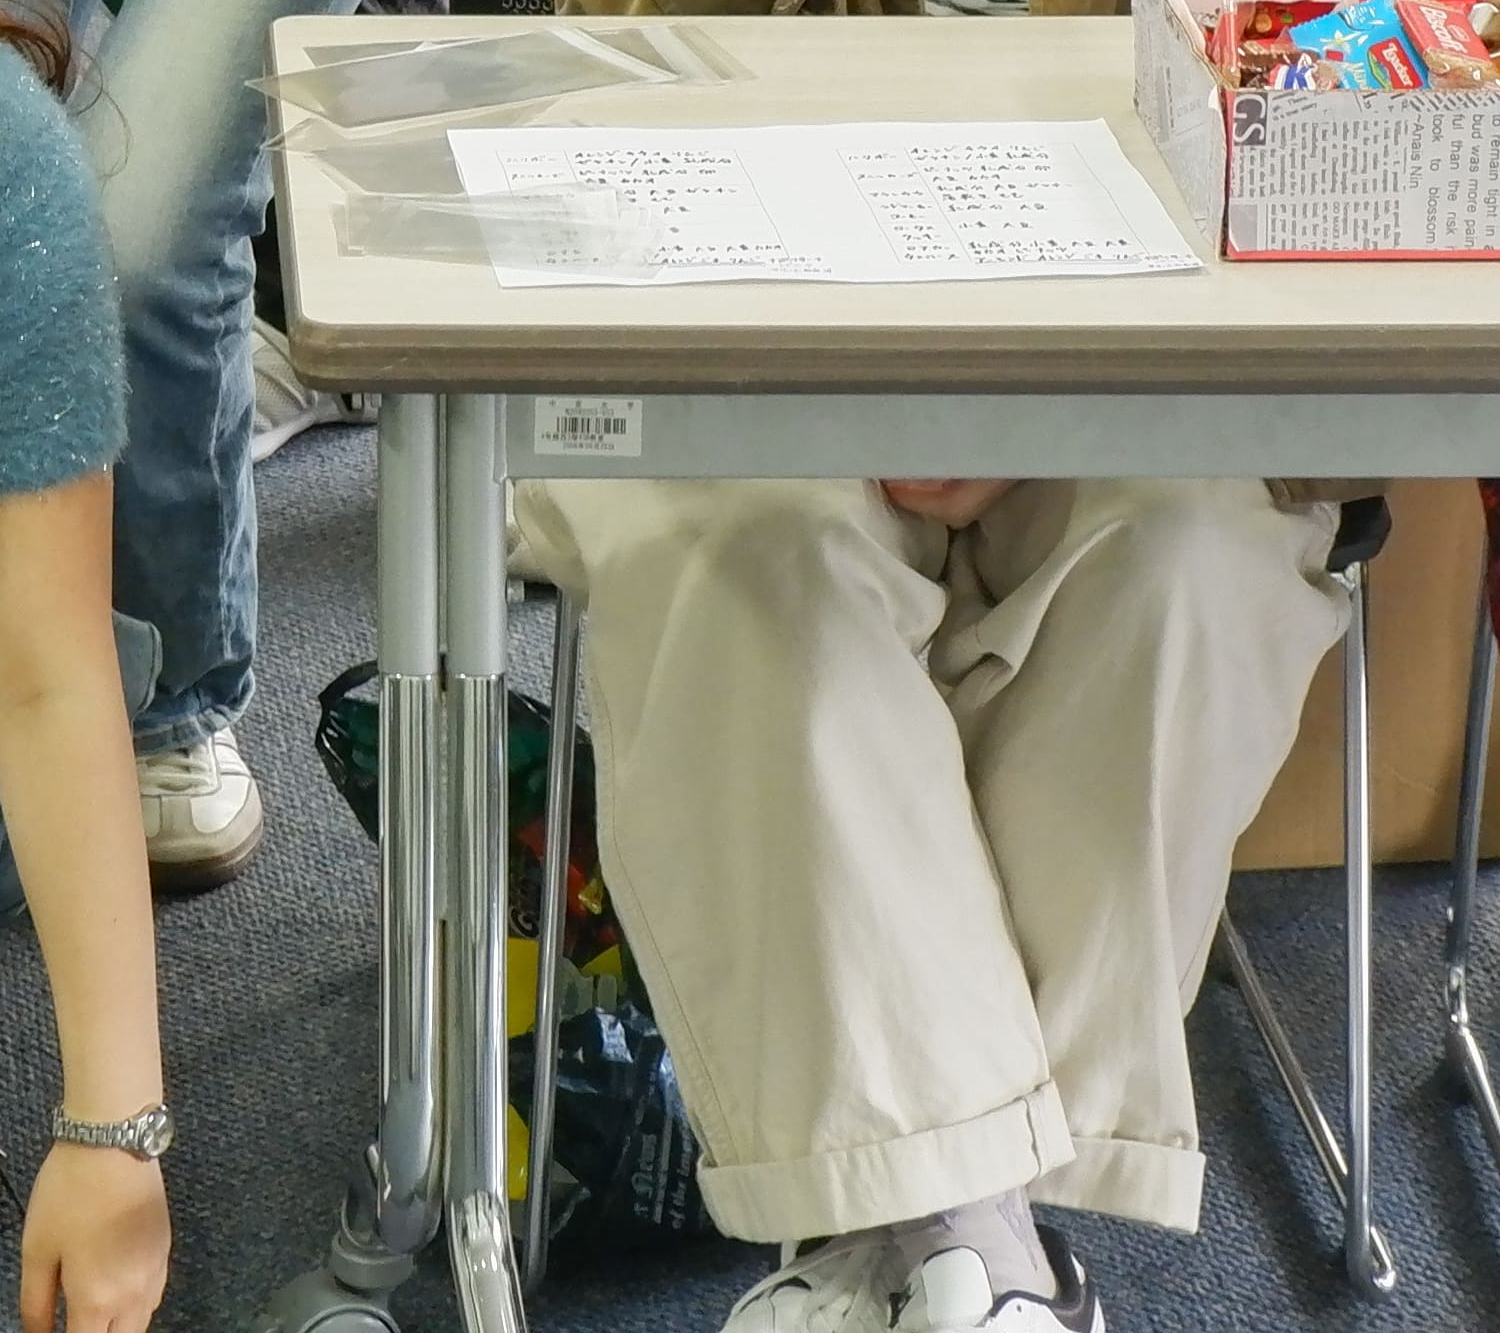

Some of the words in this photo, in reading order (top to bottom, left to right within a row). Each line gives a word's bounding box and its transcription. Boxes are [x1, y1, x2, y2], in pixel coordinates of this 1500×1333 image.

[1234, 93, 1268, 145] GS
[1431, 114, 1445, 143] took
[1472, 114, 1485, 139] bud
[1449, 139, 1463, 170] than
[1469, 144, 1482, 173] was
[1409, 164, 1423, 190] Nin
[1447, 179, 1461, 202] the
[1466, 178, 1479, 213] more
